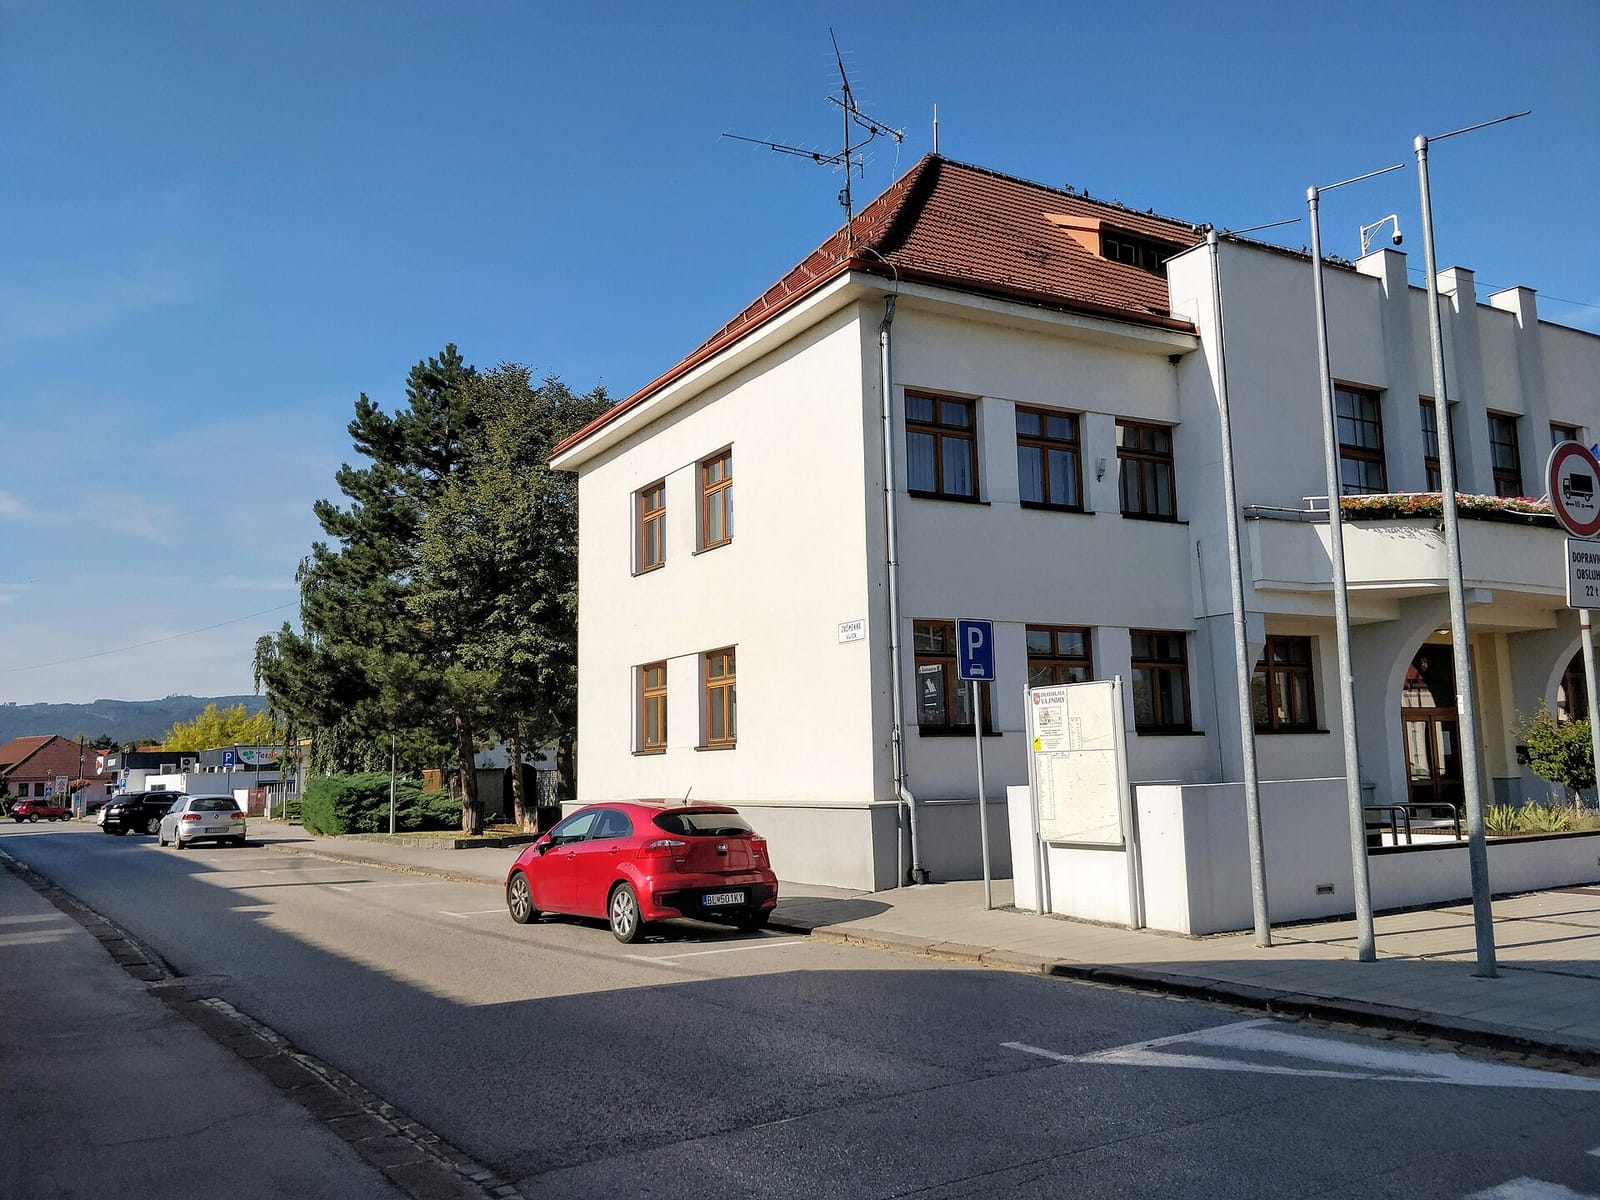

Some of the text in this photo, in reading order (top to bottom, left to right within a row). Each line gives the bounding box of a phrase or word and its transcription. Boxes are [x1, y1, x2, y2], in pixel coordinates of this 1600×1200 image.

[1585, 585, 1594, 597] 22
[967, 626, 984, 660] P
[225, 752, 232, 762] P
